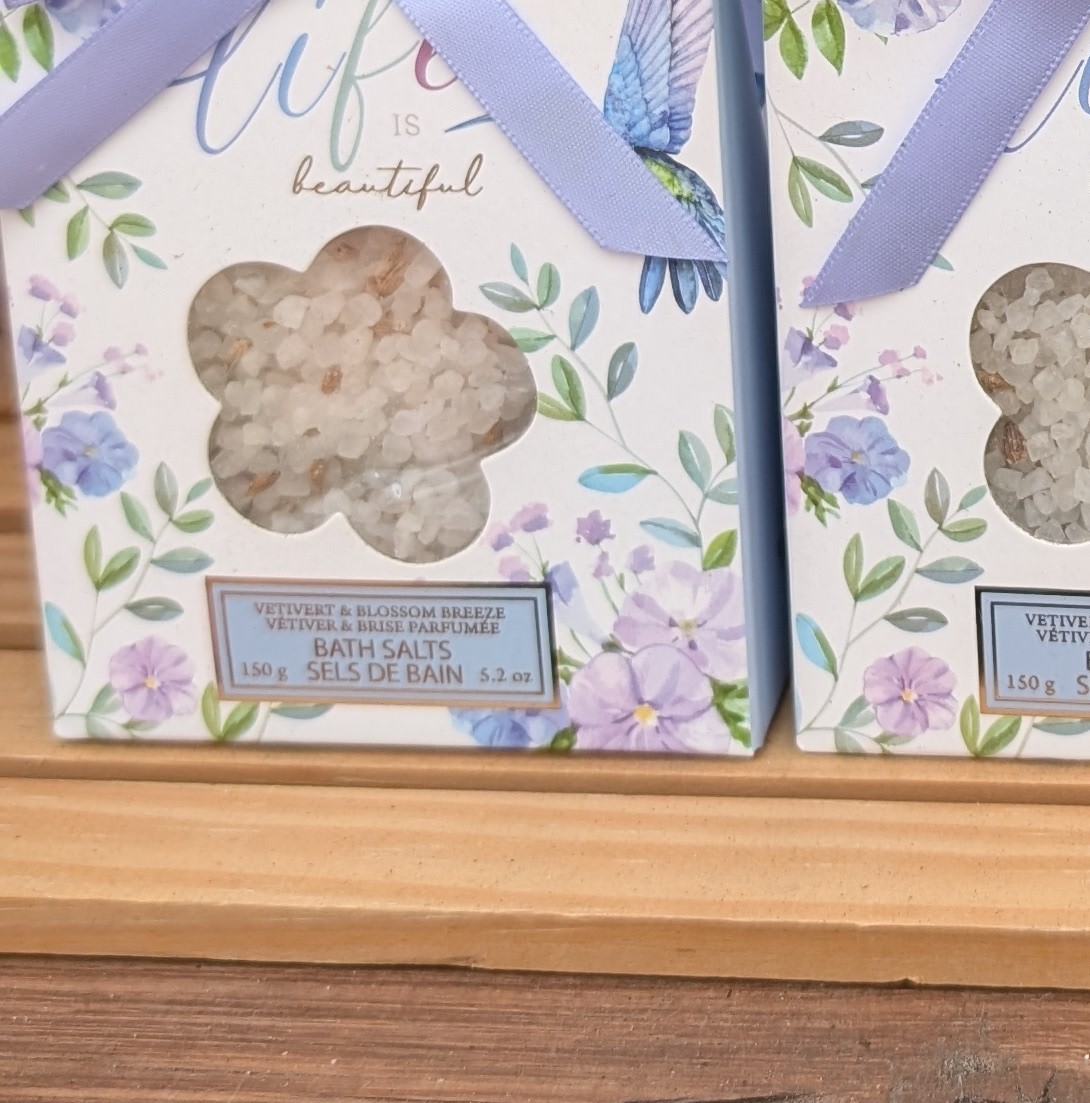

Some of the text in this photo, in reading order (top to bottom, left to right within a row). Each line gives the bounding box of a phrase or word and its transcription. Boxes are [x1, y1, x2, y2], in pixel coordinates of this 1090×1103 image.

[393, 113, 421, 136] IS
[292, 153, 484, 211] beautiful
[254, 602, 506, 620] VETIVERT & BLOSSOM BREEZE
[266, 615, 501, 635] VÉTIVER & BRISE PARFUMÉE
[314, 638, 452, 660] BATH SALTS
[242, 661, 533, 684] 150 g SELS DE BAIN 5.2 oz
[1007, 674, 1039, 690] 150
[1045, 680, 1056, 696] g
